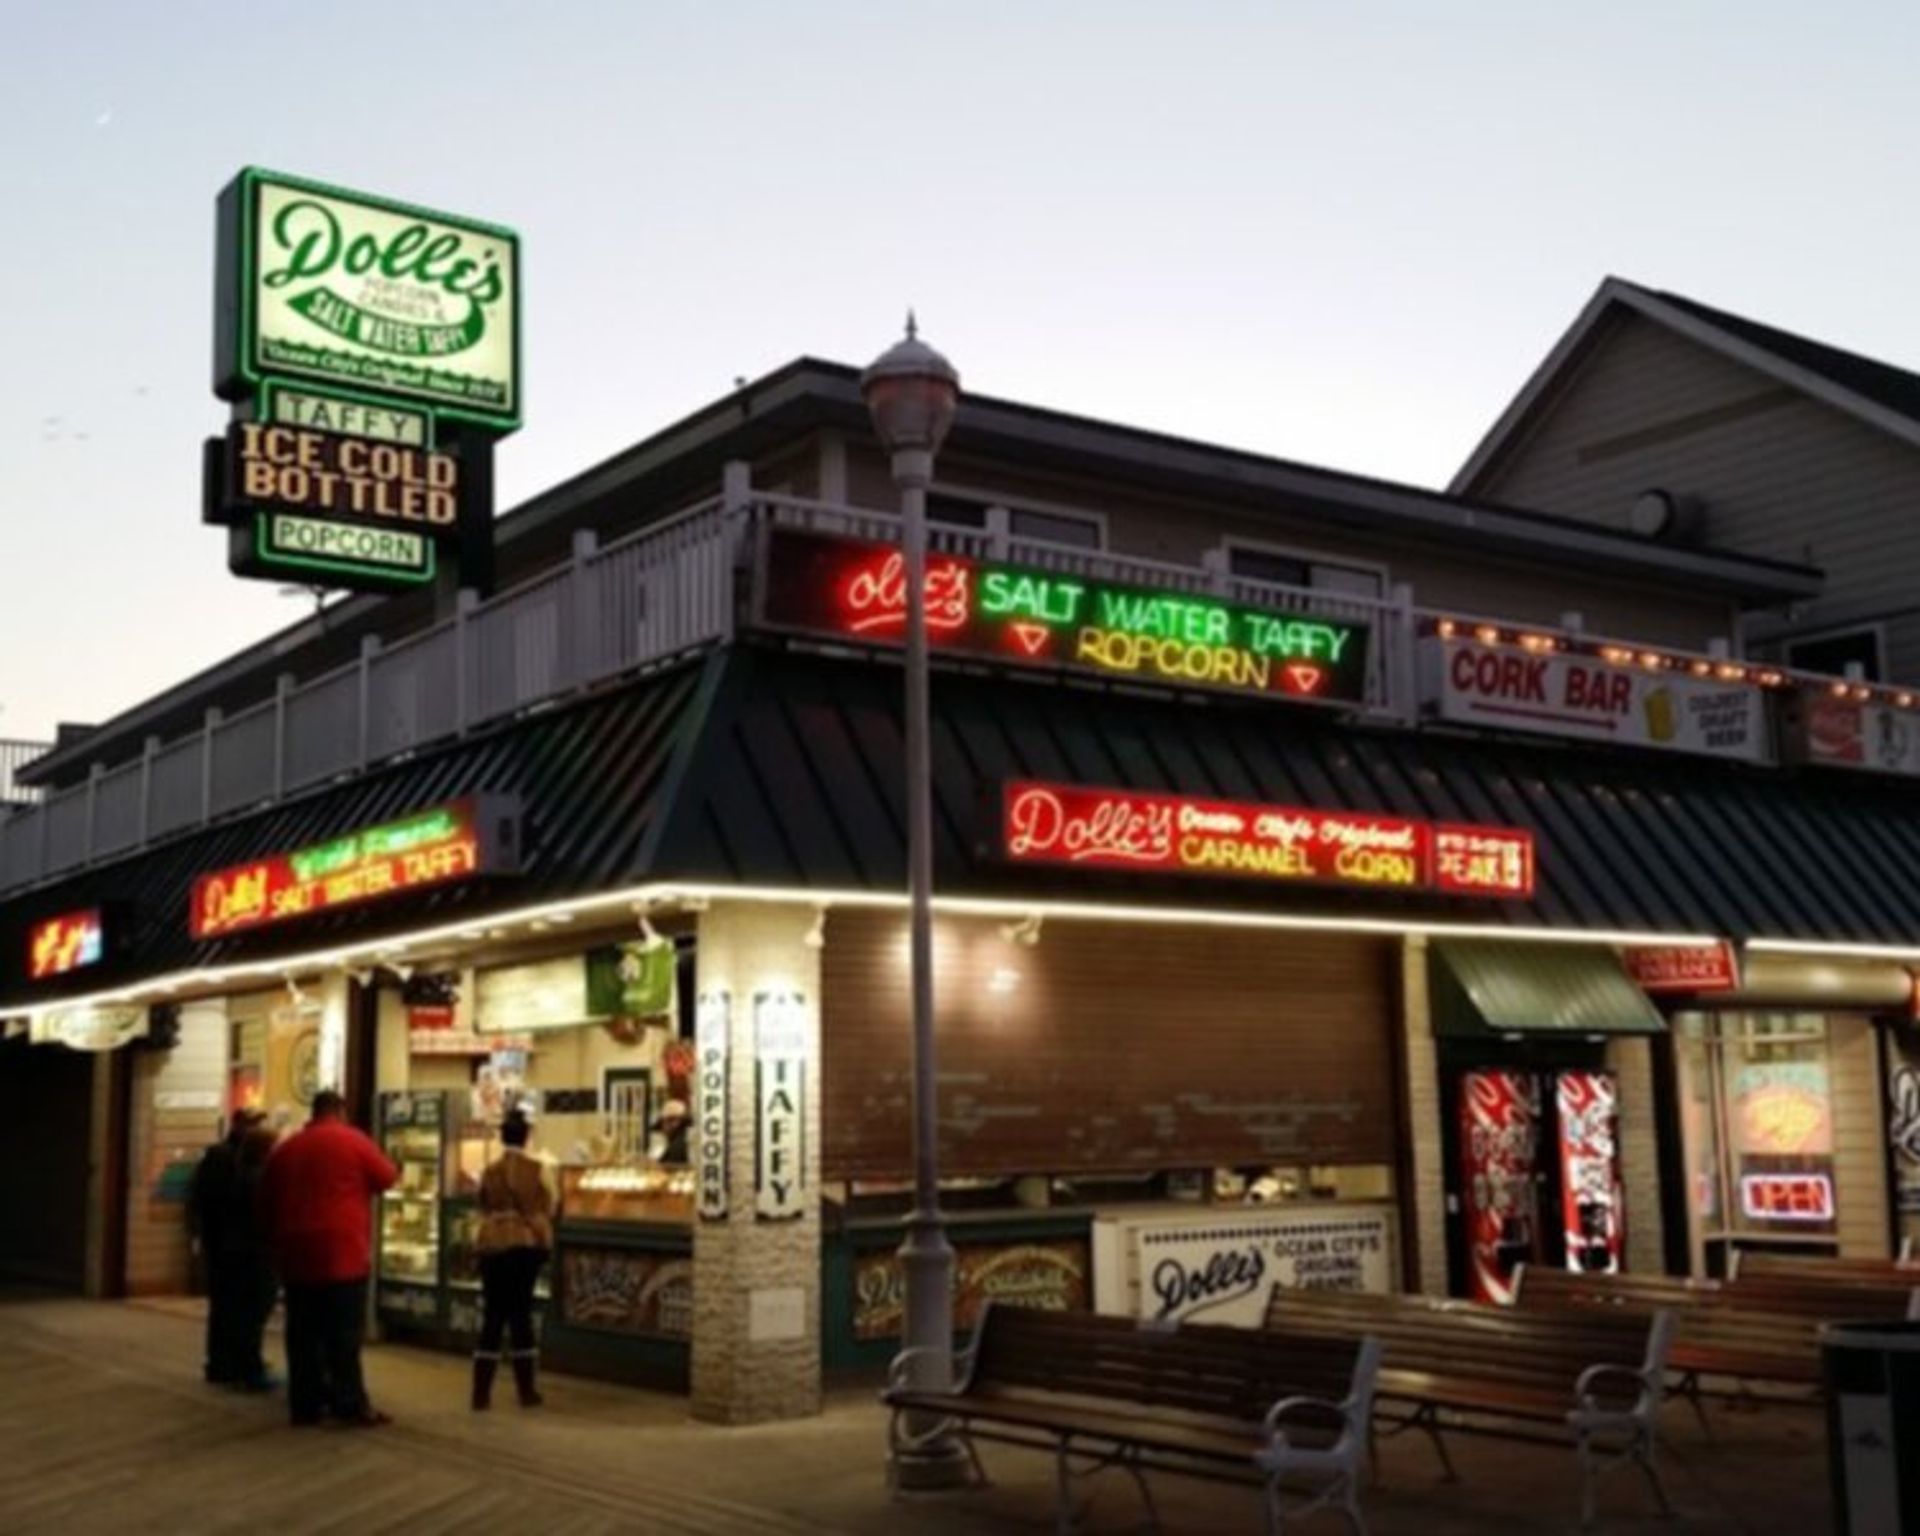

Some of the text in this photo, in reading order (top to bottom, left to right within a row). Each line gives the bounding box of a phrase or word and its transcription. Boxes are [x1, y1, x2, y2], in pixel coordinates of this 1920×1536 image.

[262, 200, 503, 304] Dolle's
[305, 287, 356, 337] SALT
[289, 394, 410, 437] TAFFY
[241, 422, 457, 489] ICE COLD
[244, 460, 457, 525] BOTTLED
[278, 520, 417, 560] POPCORN
[982, 572, 1349, 663] SALT WATER TAFFY
[1451, 649, 1632, 717] CORK BAR
[404, 839, 477, 884] TAFFY
[1180, 835, 1316, 877] CARAMEL
[1334, 848, 1416, 884] CORN
[702, 1048, 722, 1206] POPCORN
[767, 1059, 795, 1206] TAFFY
